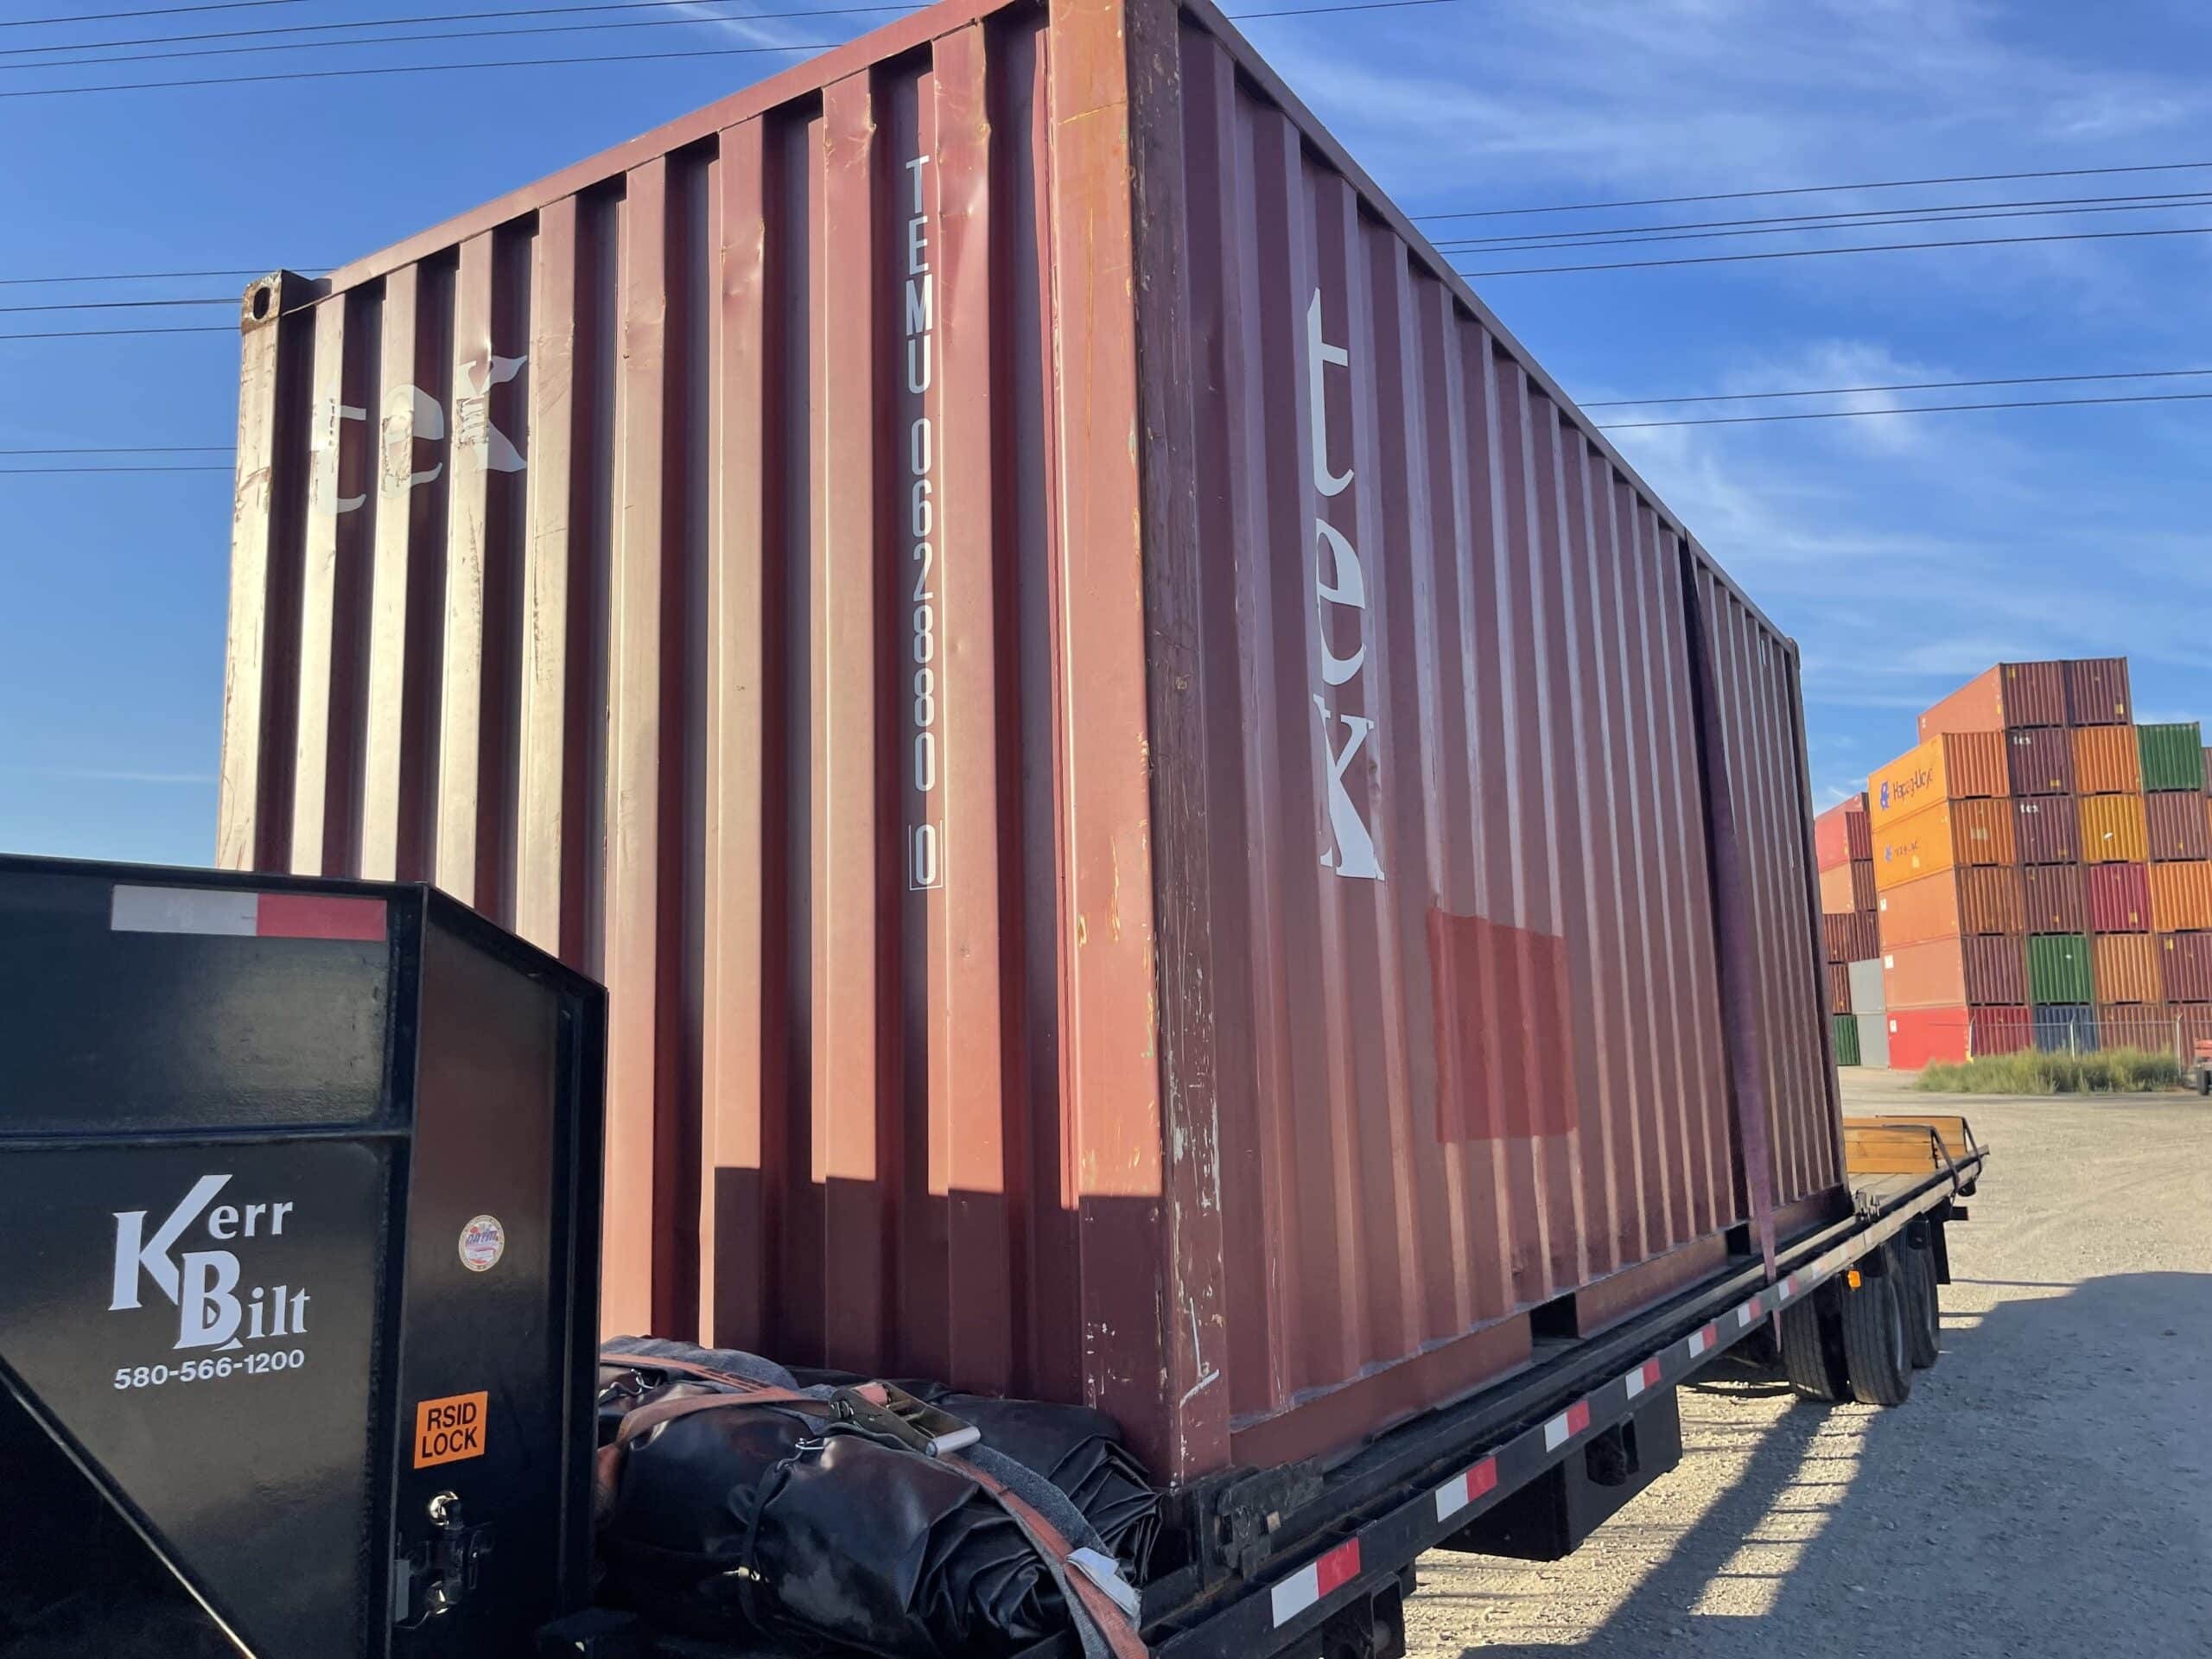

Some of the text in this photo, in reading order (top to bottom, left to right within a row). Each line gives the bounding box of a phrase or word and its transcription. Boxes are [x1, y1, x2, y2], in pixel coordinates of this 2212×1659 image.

[905, 155, 933, 394] TEMU
[911, 417, 936, 792] 062880
[107, 1173, 294, 1311] Kerr
[172, 1249, 311, 1352] Bilt
[113, 1349, 306, 1390] 580-566-1200
[427, 1402, 477, 1430] RSID
[421, 1426, 478, 1459] LOCK
